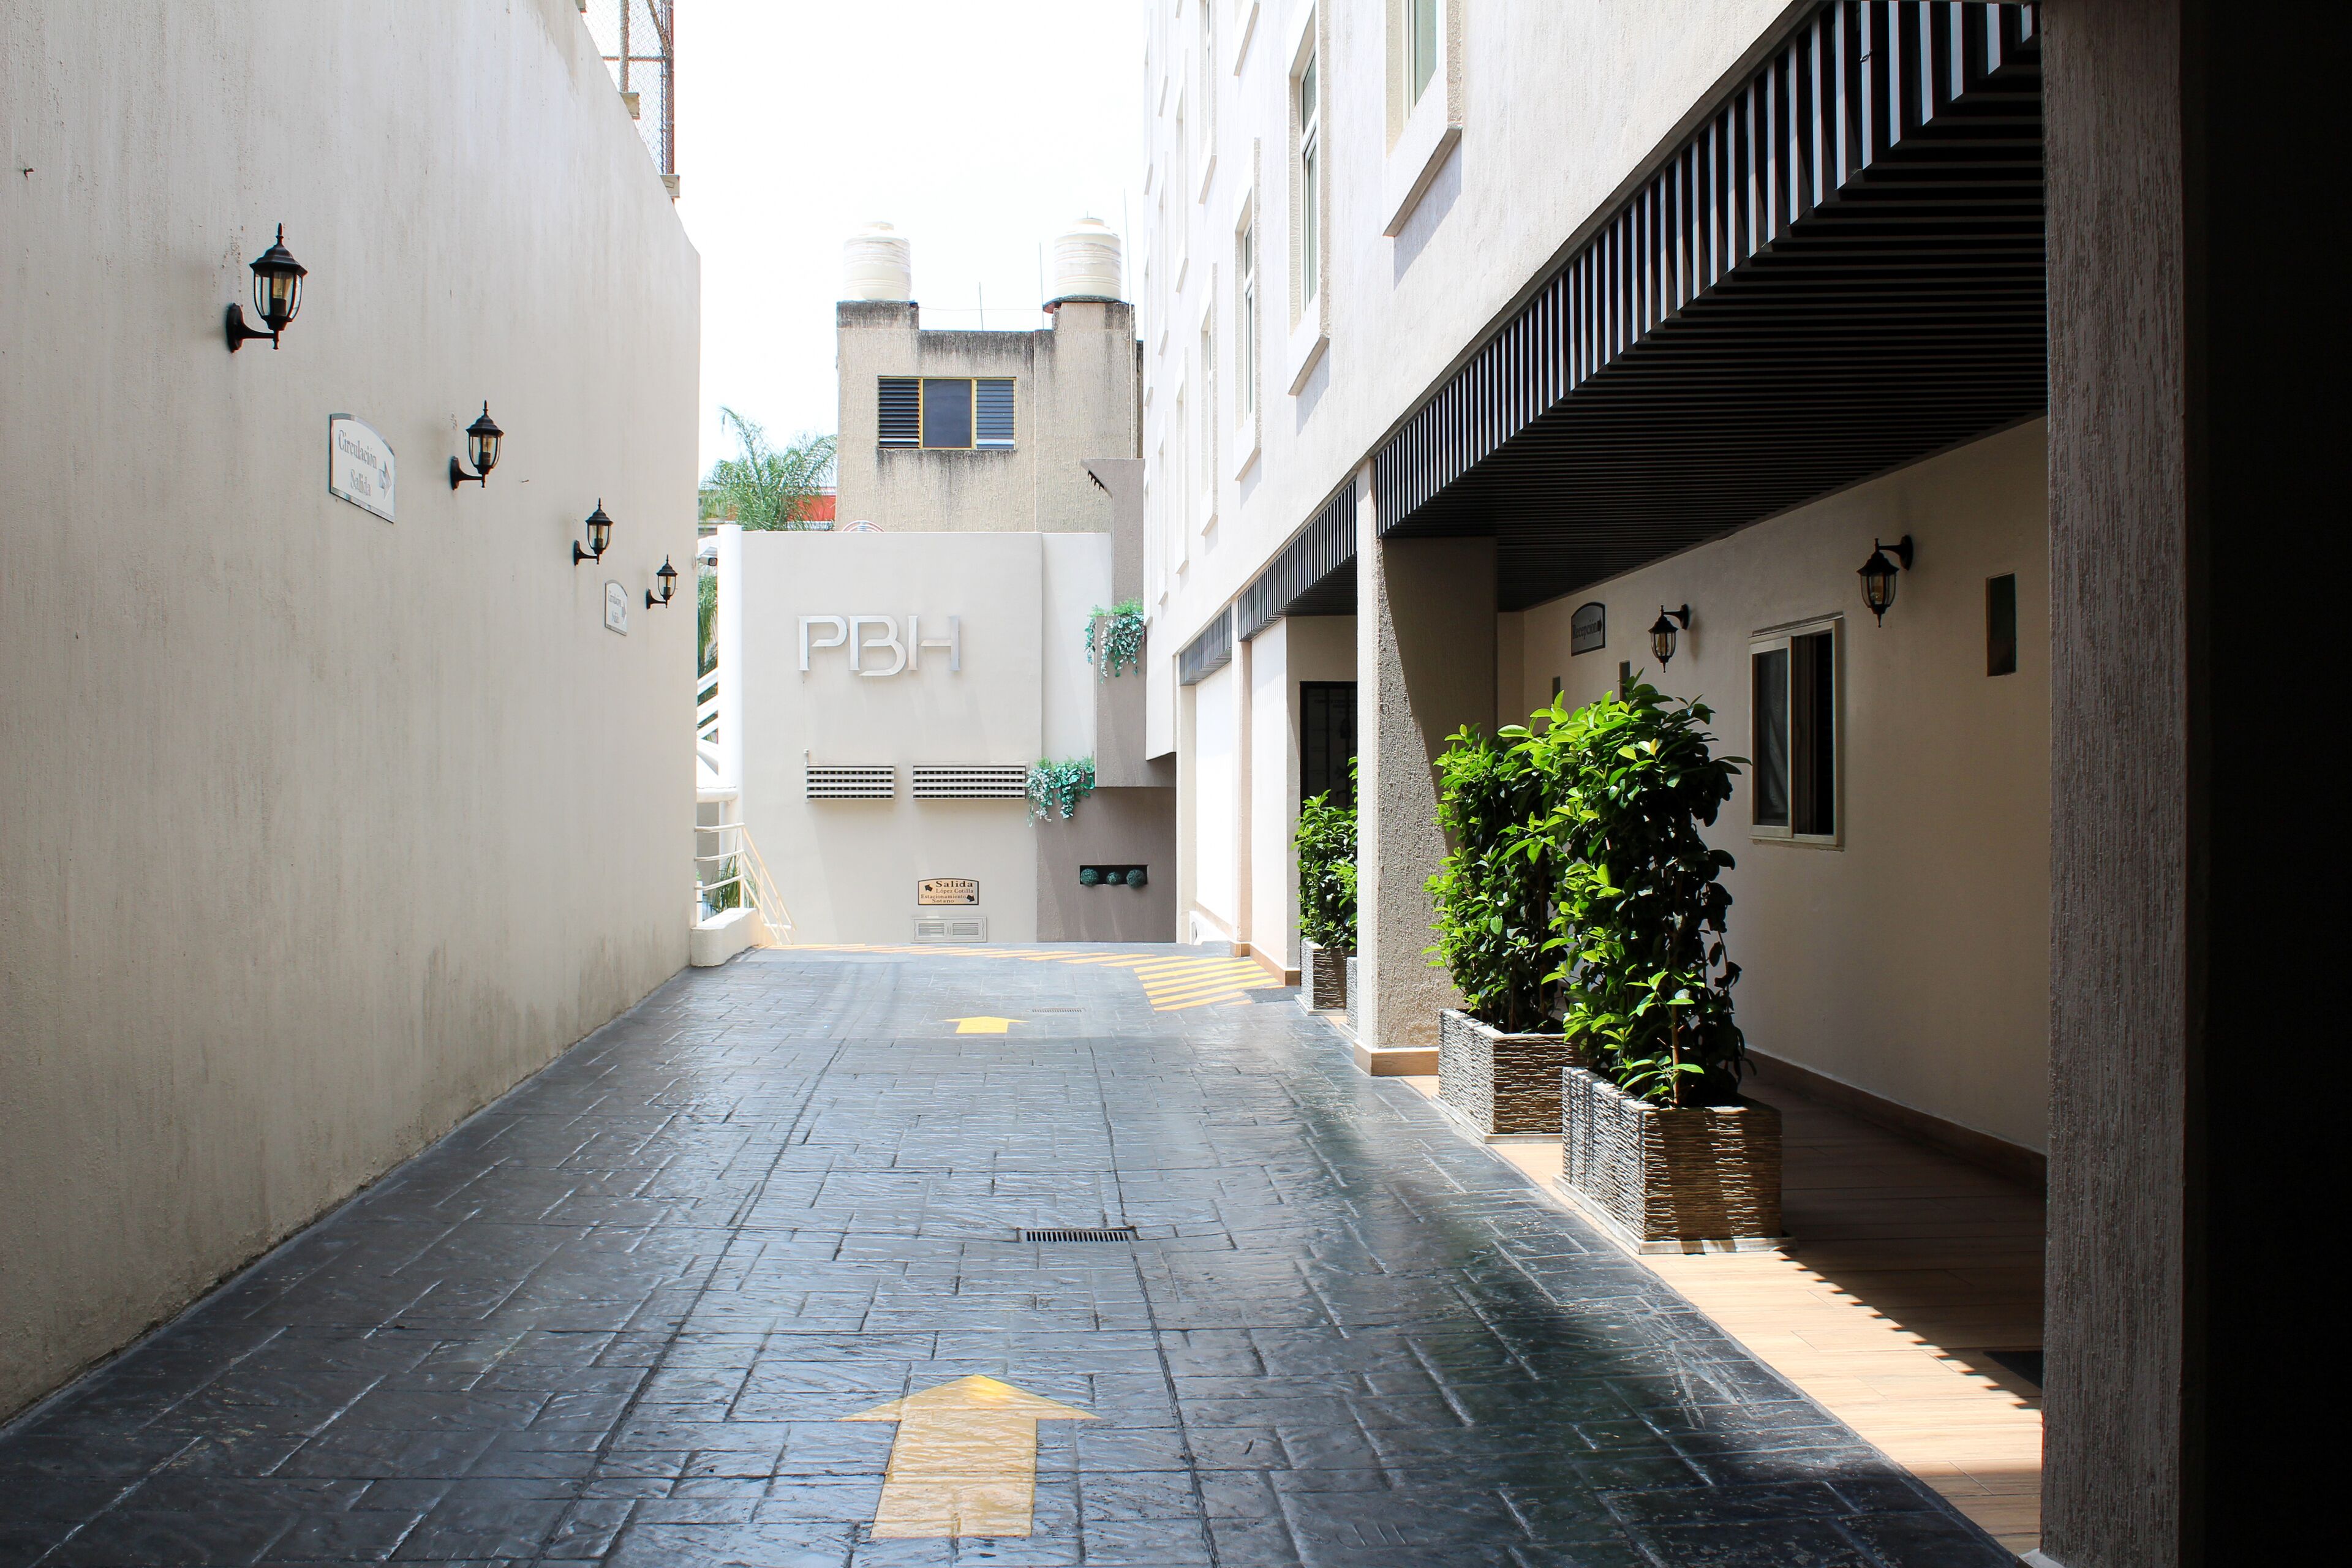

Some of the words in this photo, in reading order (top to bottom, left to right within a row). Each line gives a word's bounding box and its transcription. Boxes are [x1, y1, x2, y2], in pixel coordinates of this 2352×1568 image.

[339, 429, 377, 469] Circulación
[350, 469, 371, 497] Salida
[797, 614, 961, 676] PBH
